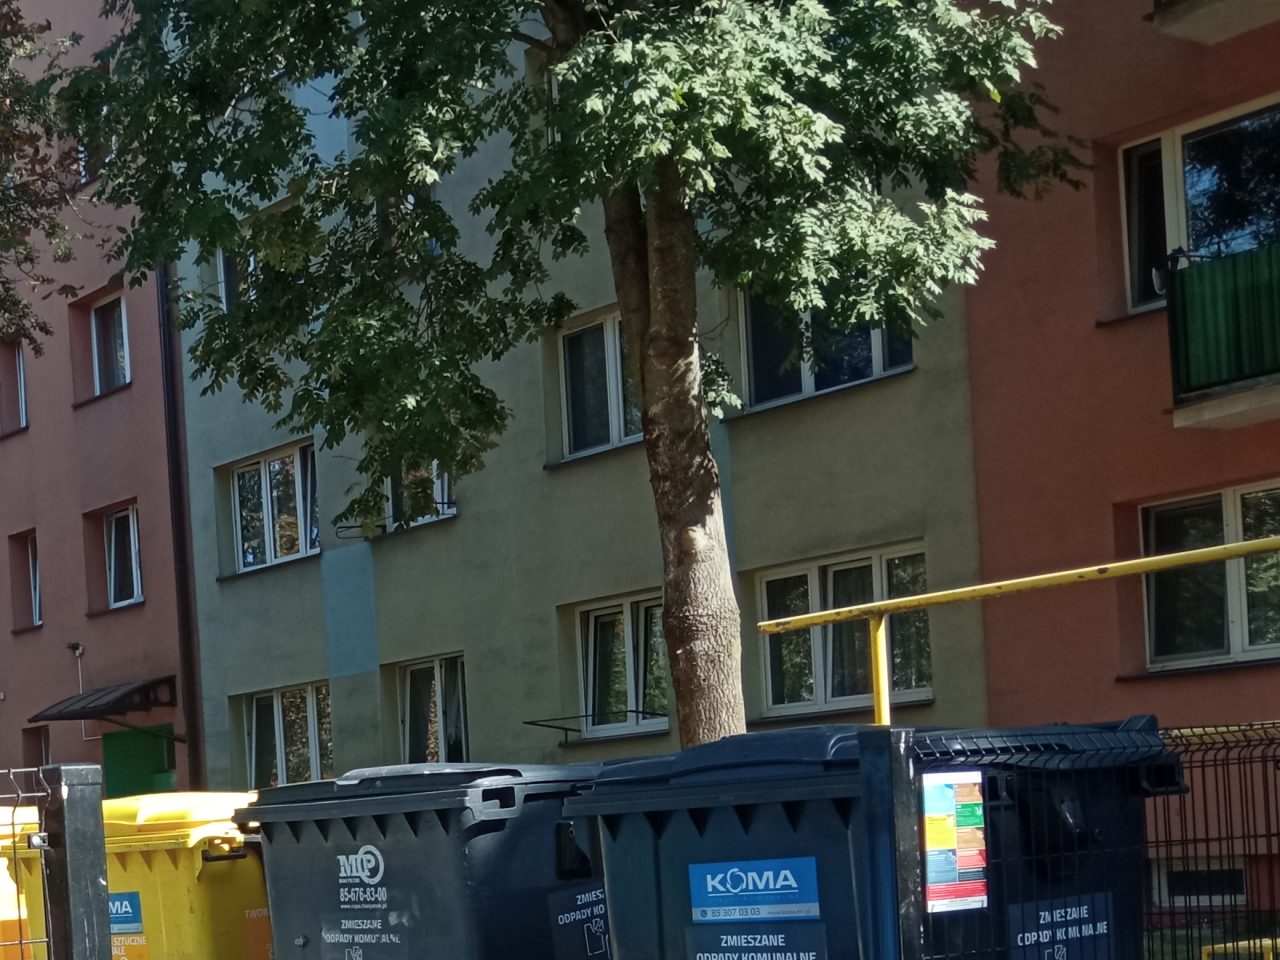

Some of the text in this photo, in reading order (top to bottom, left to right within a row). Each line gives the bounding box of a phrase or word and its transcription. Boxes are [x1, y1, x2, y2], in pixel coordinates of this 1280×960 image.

[706, 867, 798, 893] KOMA
[339, 887, 387, 902] 85-676-83-00
[575, 889, 605, 905] ZMIES
[109, 900, 133, 914] MA
[244, 908, 268, 919] TWOR
[722, 908, 737, 917] 307
[738, 907, 749, 917] 03
[750, 906, 761, 916] 03
[558, 904, 605, 925] ODPADY KO
[341, 920, 383, 929] ZMIESZANE
[325, 934, 353, 943] ODPADY
[720, 934, 786, 947] ZMIESZANE
